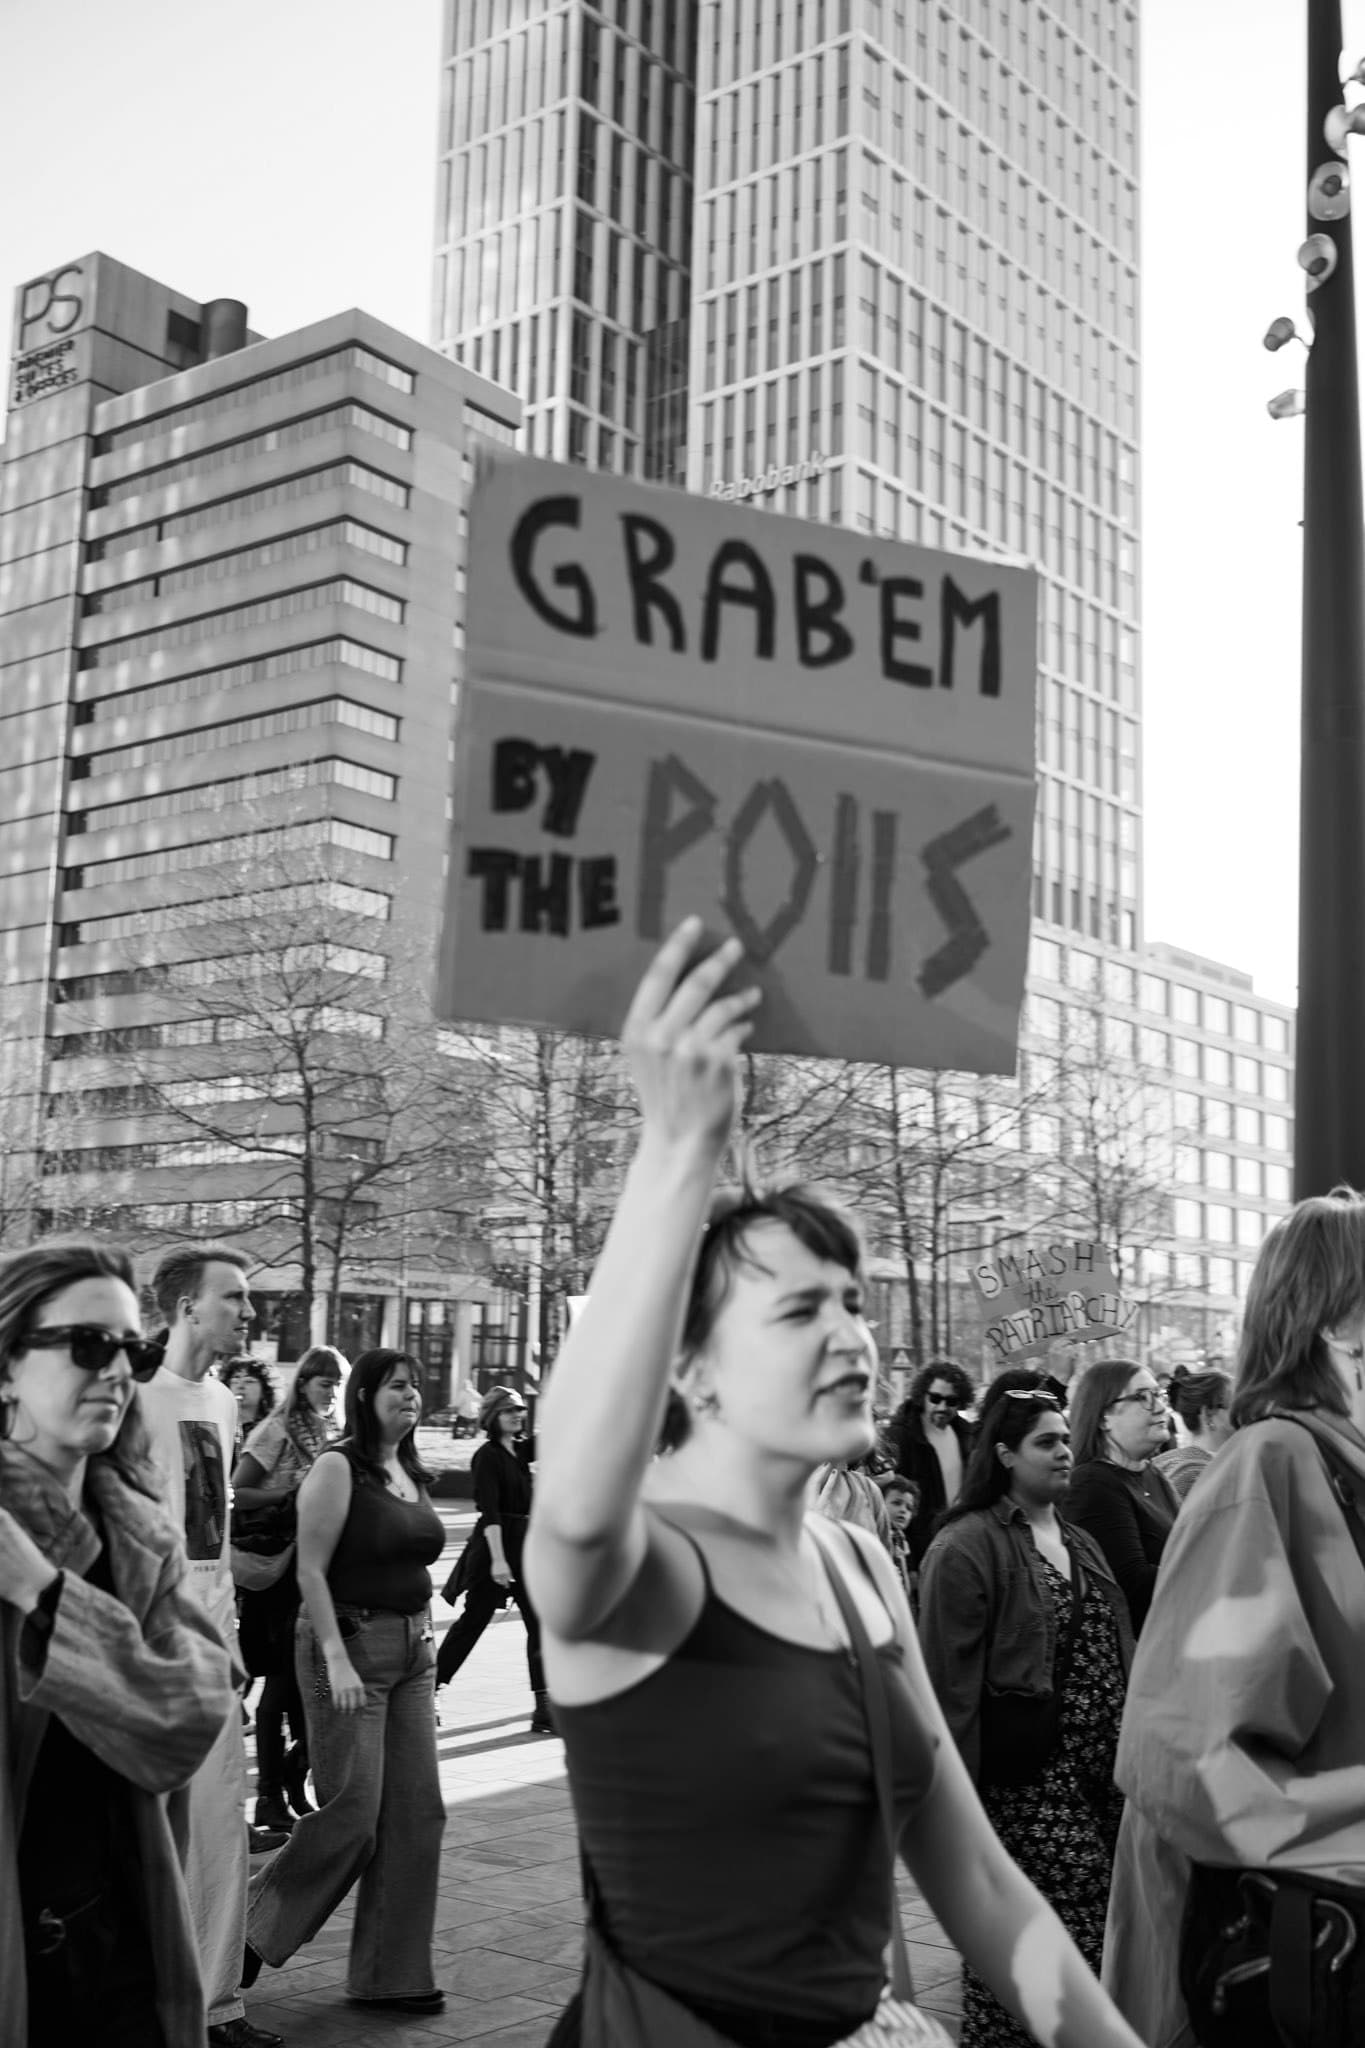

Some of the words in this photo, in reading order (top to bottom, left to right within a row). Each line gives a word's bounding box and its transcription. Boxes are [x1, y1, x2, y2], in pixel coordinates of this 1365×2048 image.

[710, 451, 827, 501] Rabobank
[491, 737, 595, 838] BY
[467, 847, 621, 938] THE
[977, 1242, 1094, 1294] SMASH
[985, 1294, 1138, 1357] PATRIARCHY
